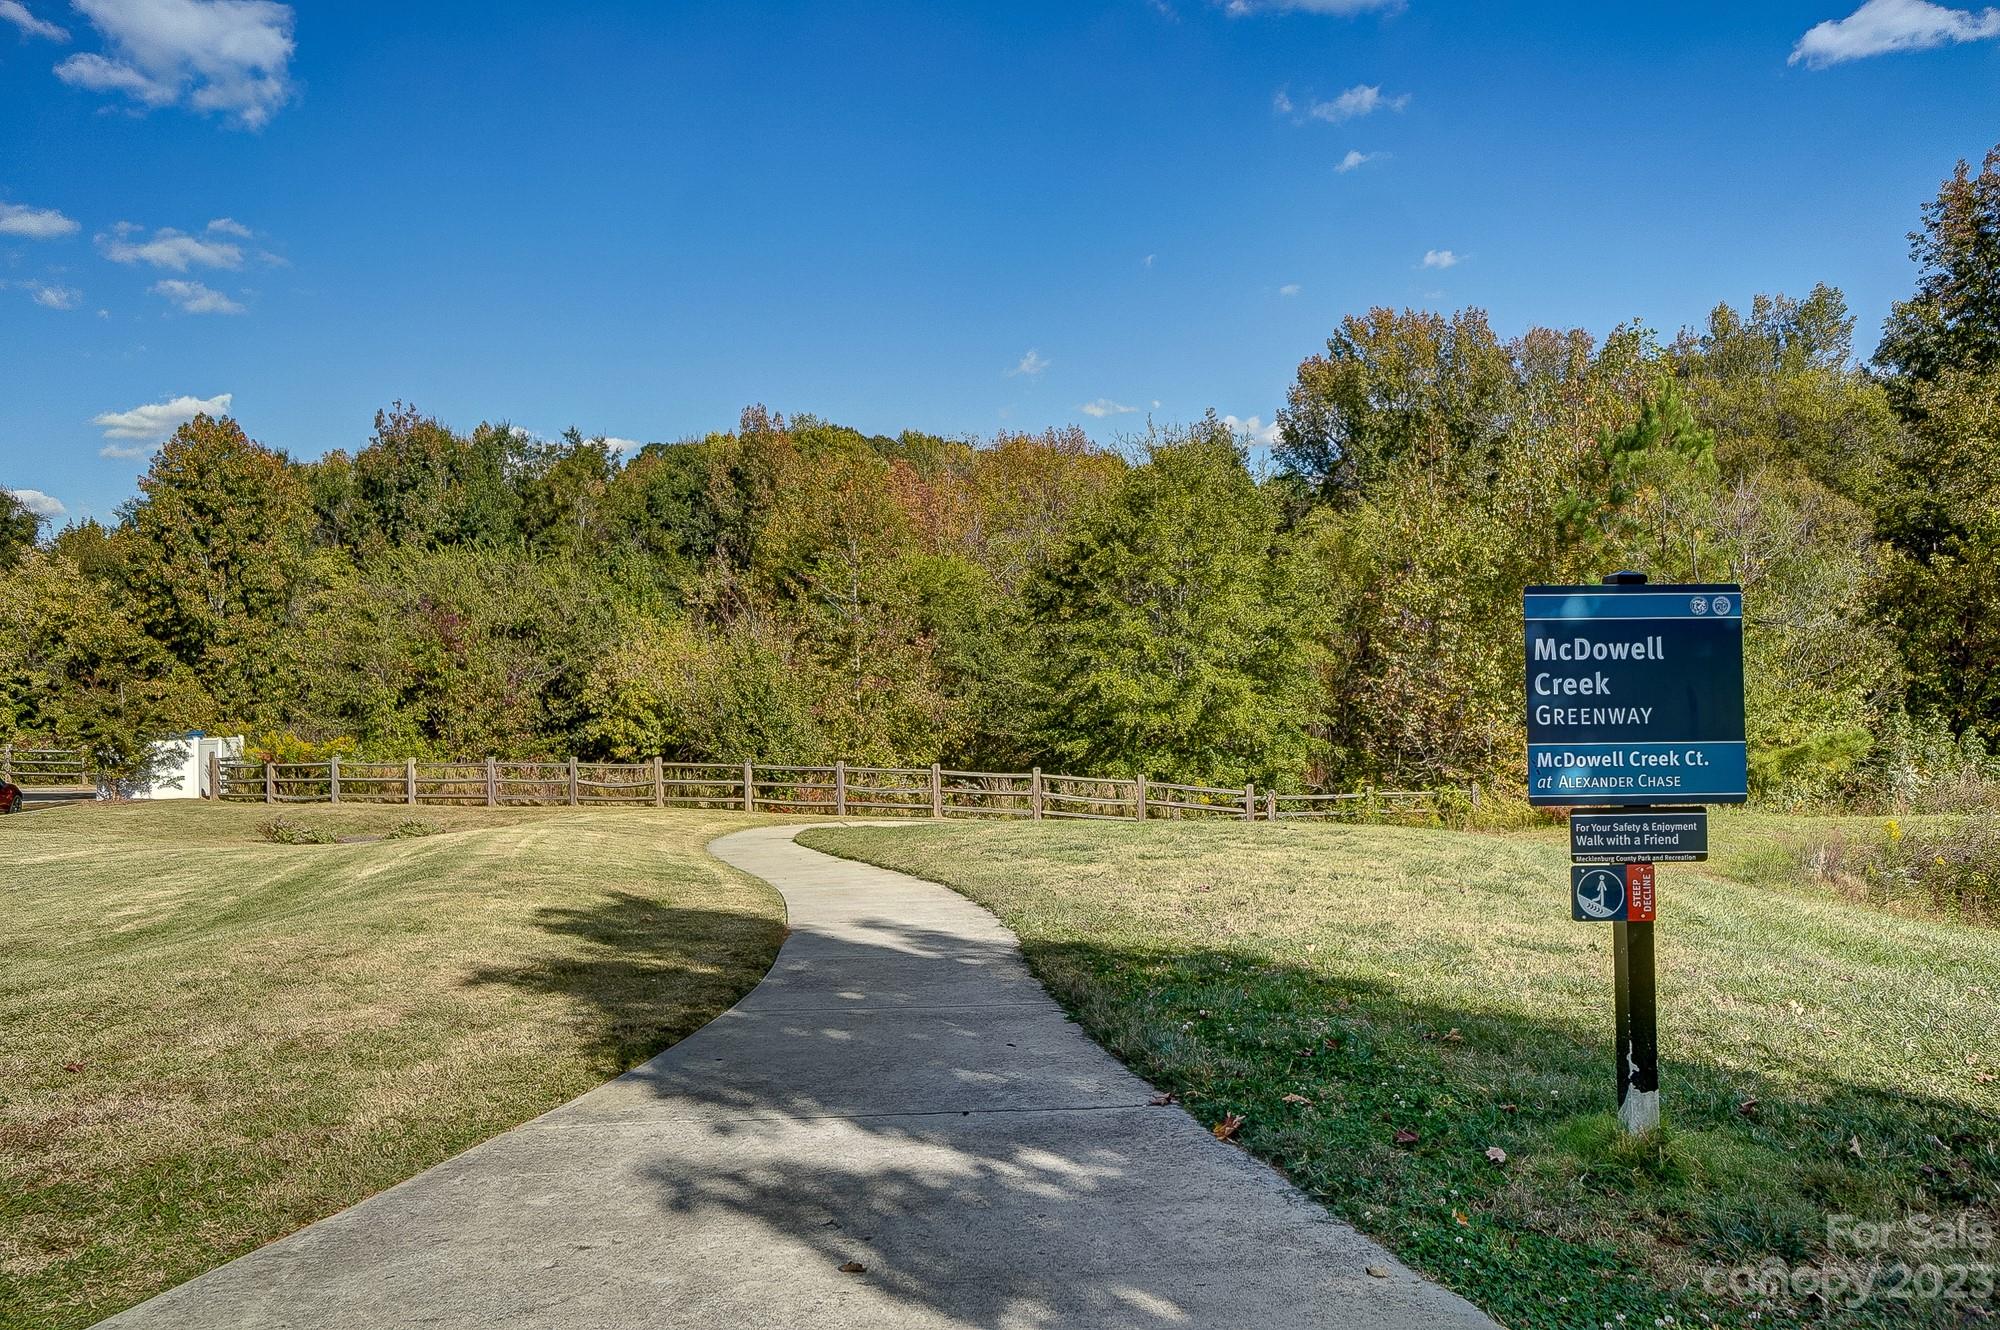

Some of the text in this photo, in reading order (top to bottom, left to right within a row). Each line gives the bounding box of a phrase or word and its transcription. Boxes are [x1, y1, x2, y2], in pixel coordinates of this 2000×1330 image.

[1534, 636, 1664, 661] McDowell
[1534, 671, 1611, 696] Creek
[1535, 705, 1652, 726] GREENWAY
[1537, 750, 1709, 768] McDowell Creek Ct.
[1537, 774, 1681, 789] at ALEXANDER CHASE
[1576, 822, 1697, 833] For Your Safety & Enjoyment
[1576, 833, 1679, 846] Walk with a Friend
[1632, 879, 1642, 908] STEEP
[1643, 874, 1652, 912] DECLINE
